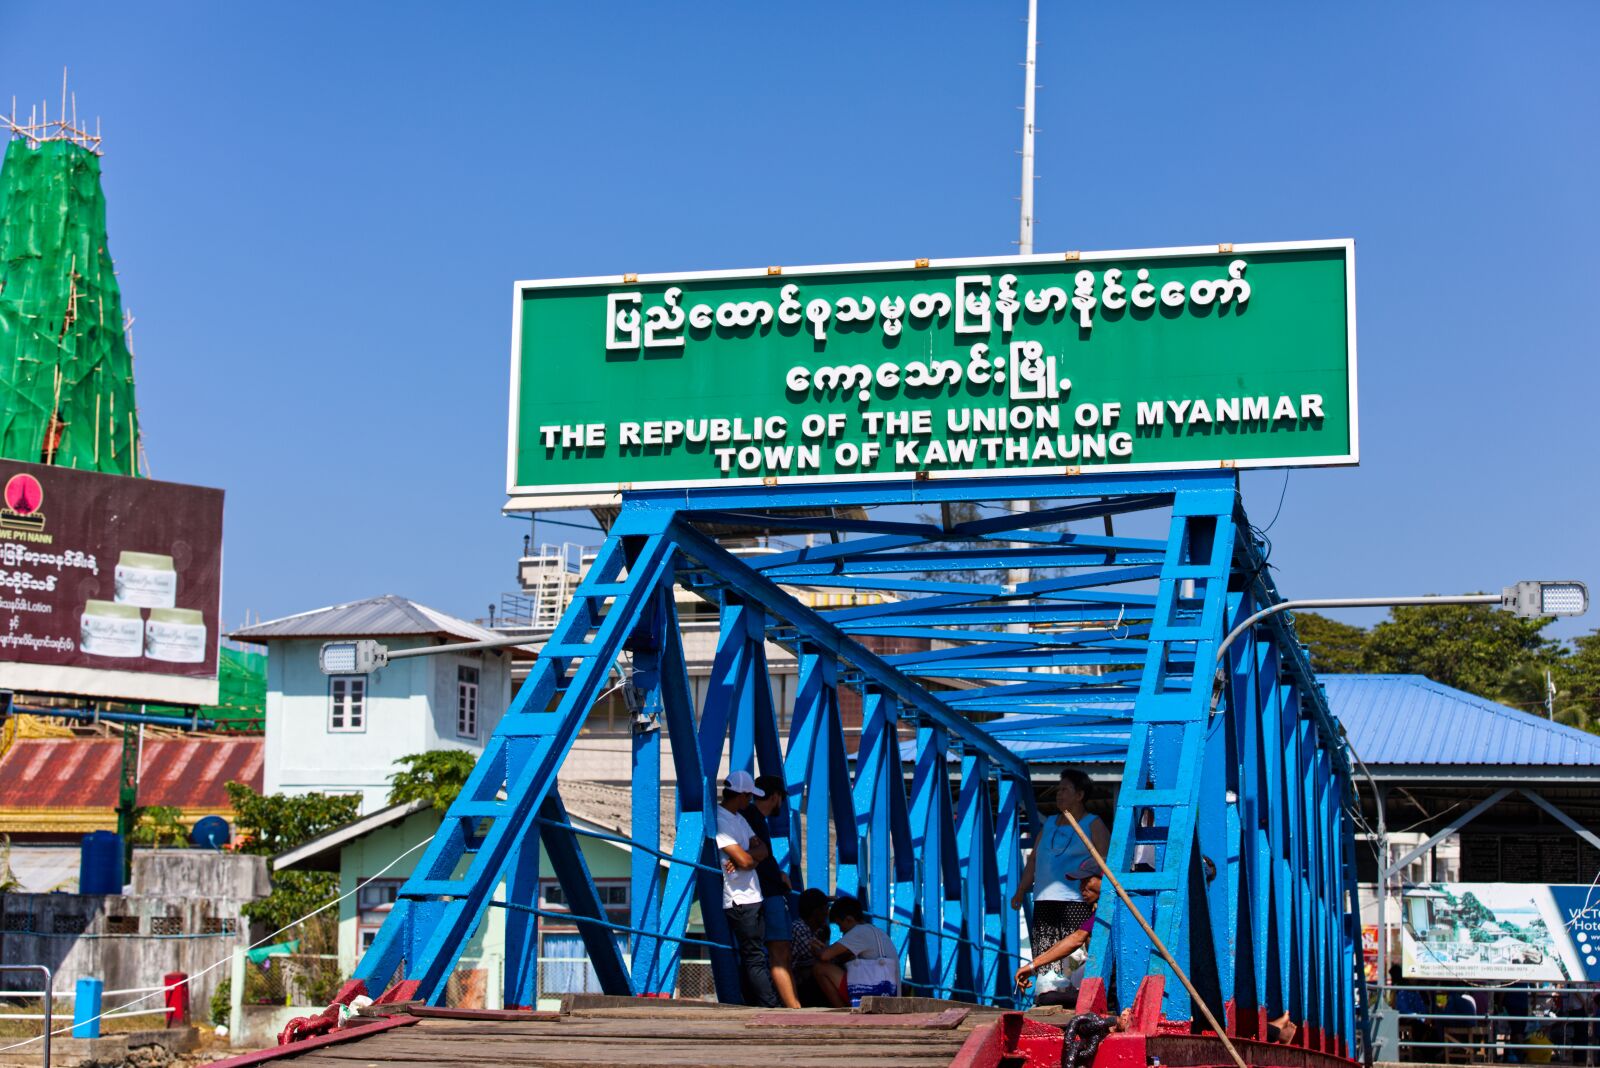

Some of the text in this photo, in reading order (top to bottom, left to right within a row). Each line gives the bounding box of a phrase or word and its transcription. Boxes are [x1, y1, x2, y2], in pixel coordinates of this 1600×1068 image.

[540, 393, 1324, 448] THE REPUBLIC OF THE UNION OF MYANMAR
[715, 431, 1133, 471] TOWN OF KAWTHAUNG
[13, 531, 27, 542] PYI
[27, 601, 52, 613] Lotion
[1569, 908, 1600, 919] VICT
